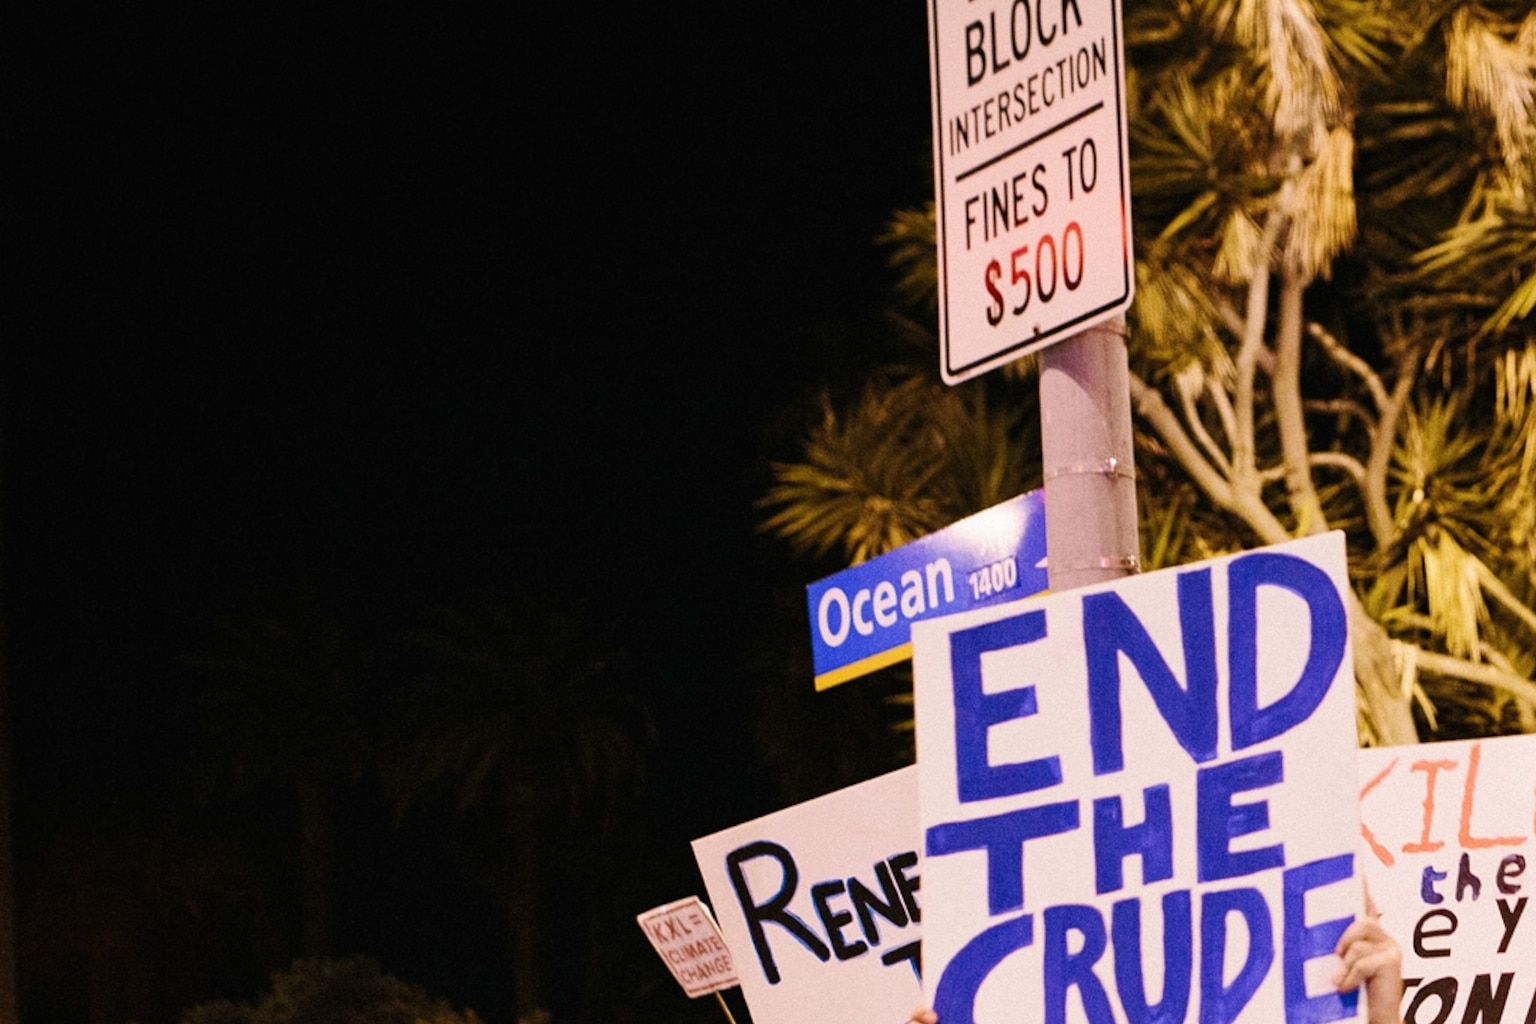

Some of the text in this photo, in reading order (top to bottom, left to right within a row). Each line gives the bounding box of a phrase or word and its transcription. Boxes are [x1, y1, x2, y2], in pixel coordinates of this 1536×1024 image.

[949, 37, 1106, 156] INTERSECTION
[964, 137, 1098, 251] FINES TO
[984, 221, 1085, 328] $500
[818, 557, 1018, 648] Ocean 1400
[948, 552, 1348, 804] END
[926, 750, 1287, 918] THE
[1420, 852, 1526, 904] the
[668, 936, 723, 964] CLIMATE
[681, 955, 732, 984] CHANGE
